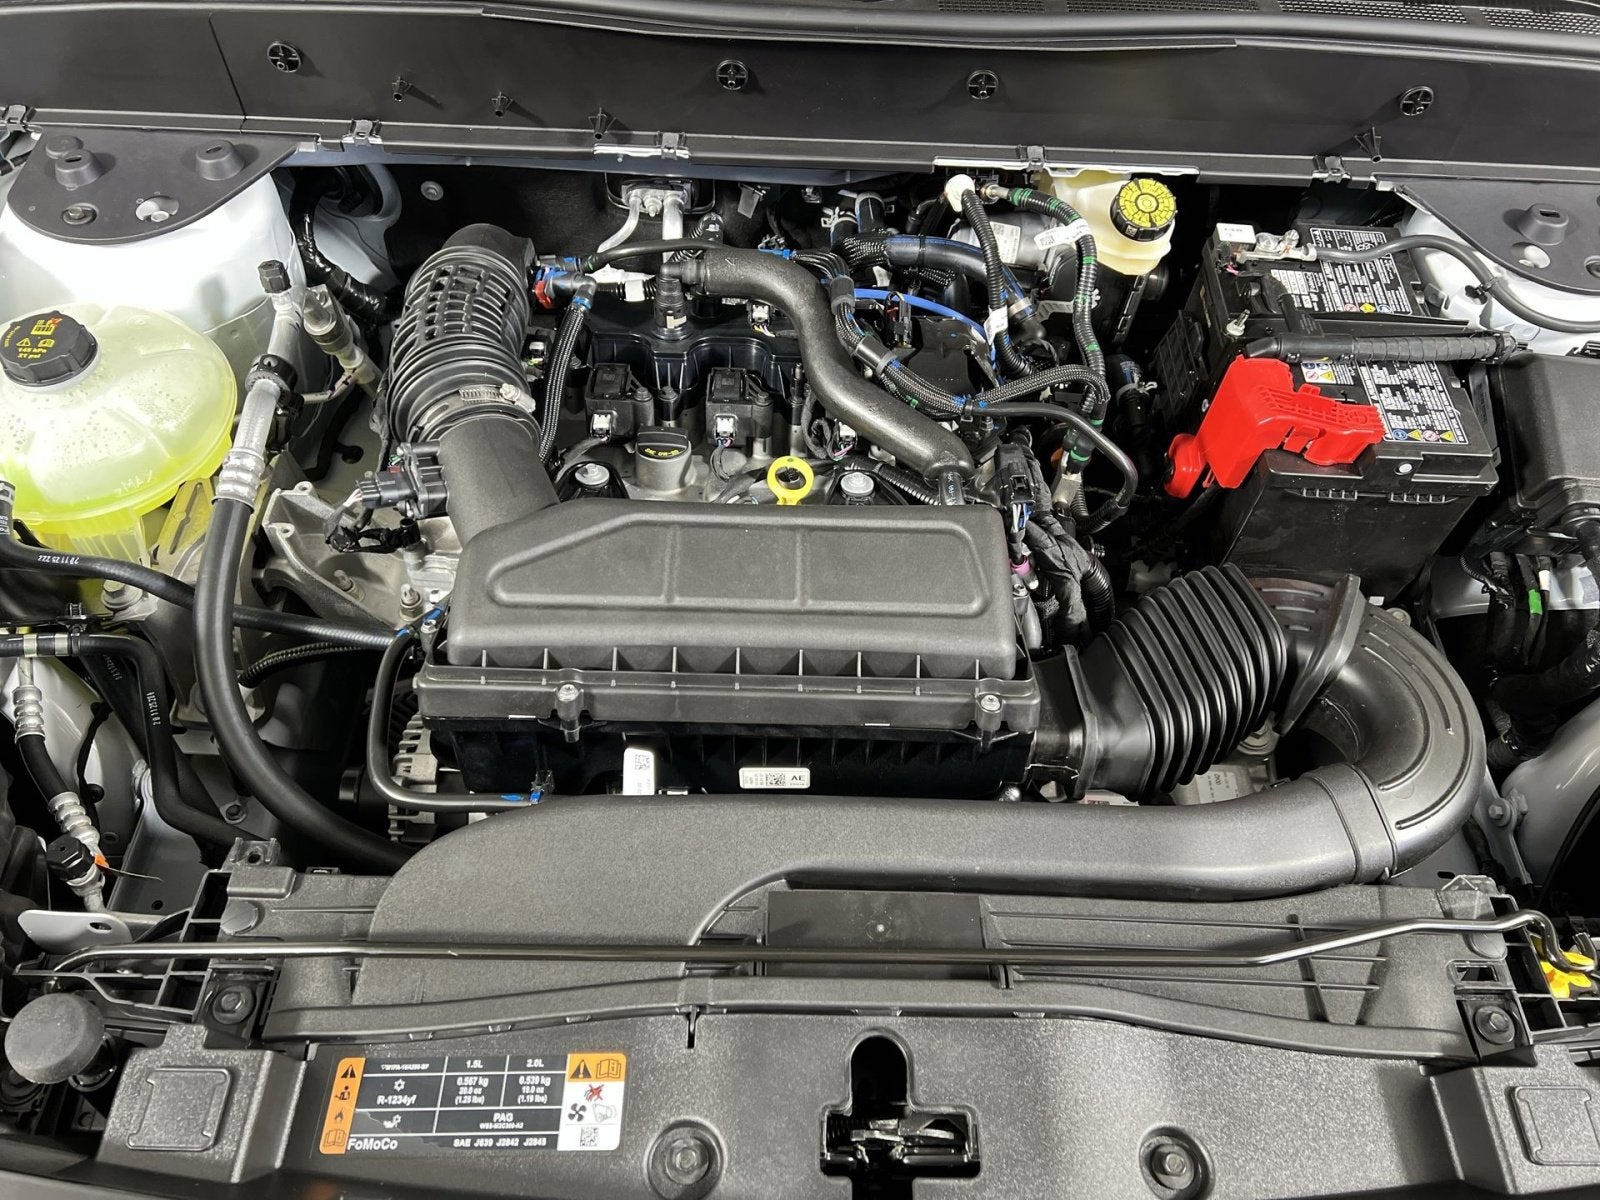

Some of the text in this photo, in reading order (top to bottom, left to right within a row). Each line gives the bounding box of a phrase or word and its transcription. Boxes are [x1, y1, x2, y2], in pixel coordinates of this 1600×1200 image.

[466, 1060, 483, 1069] 1.5L
[526, 1059, 544, 1068] 2.0L
[478, 1076, 489, 1087] kg
[540, 1076, 551, 1087] kg
[376, 1094, 417, 1106] R-1234yf
[493, 1112, 514, 1122] PAG
[347, 1137, 398, 1151] FoMoCo
[453, 1138, 472, 1147] SAE
[474, 1138, 494, 1147] J639
